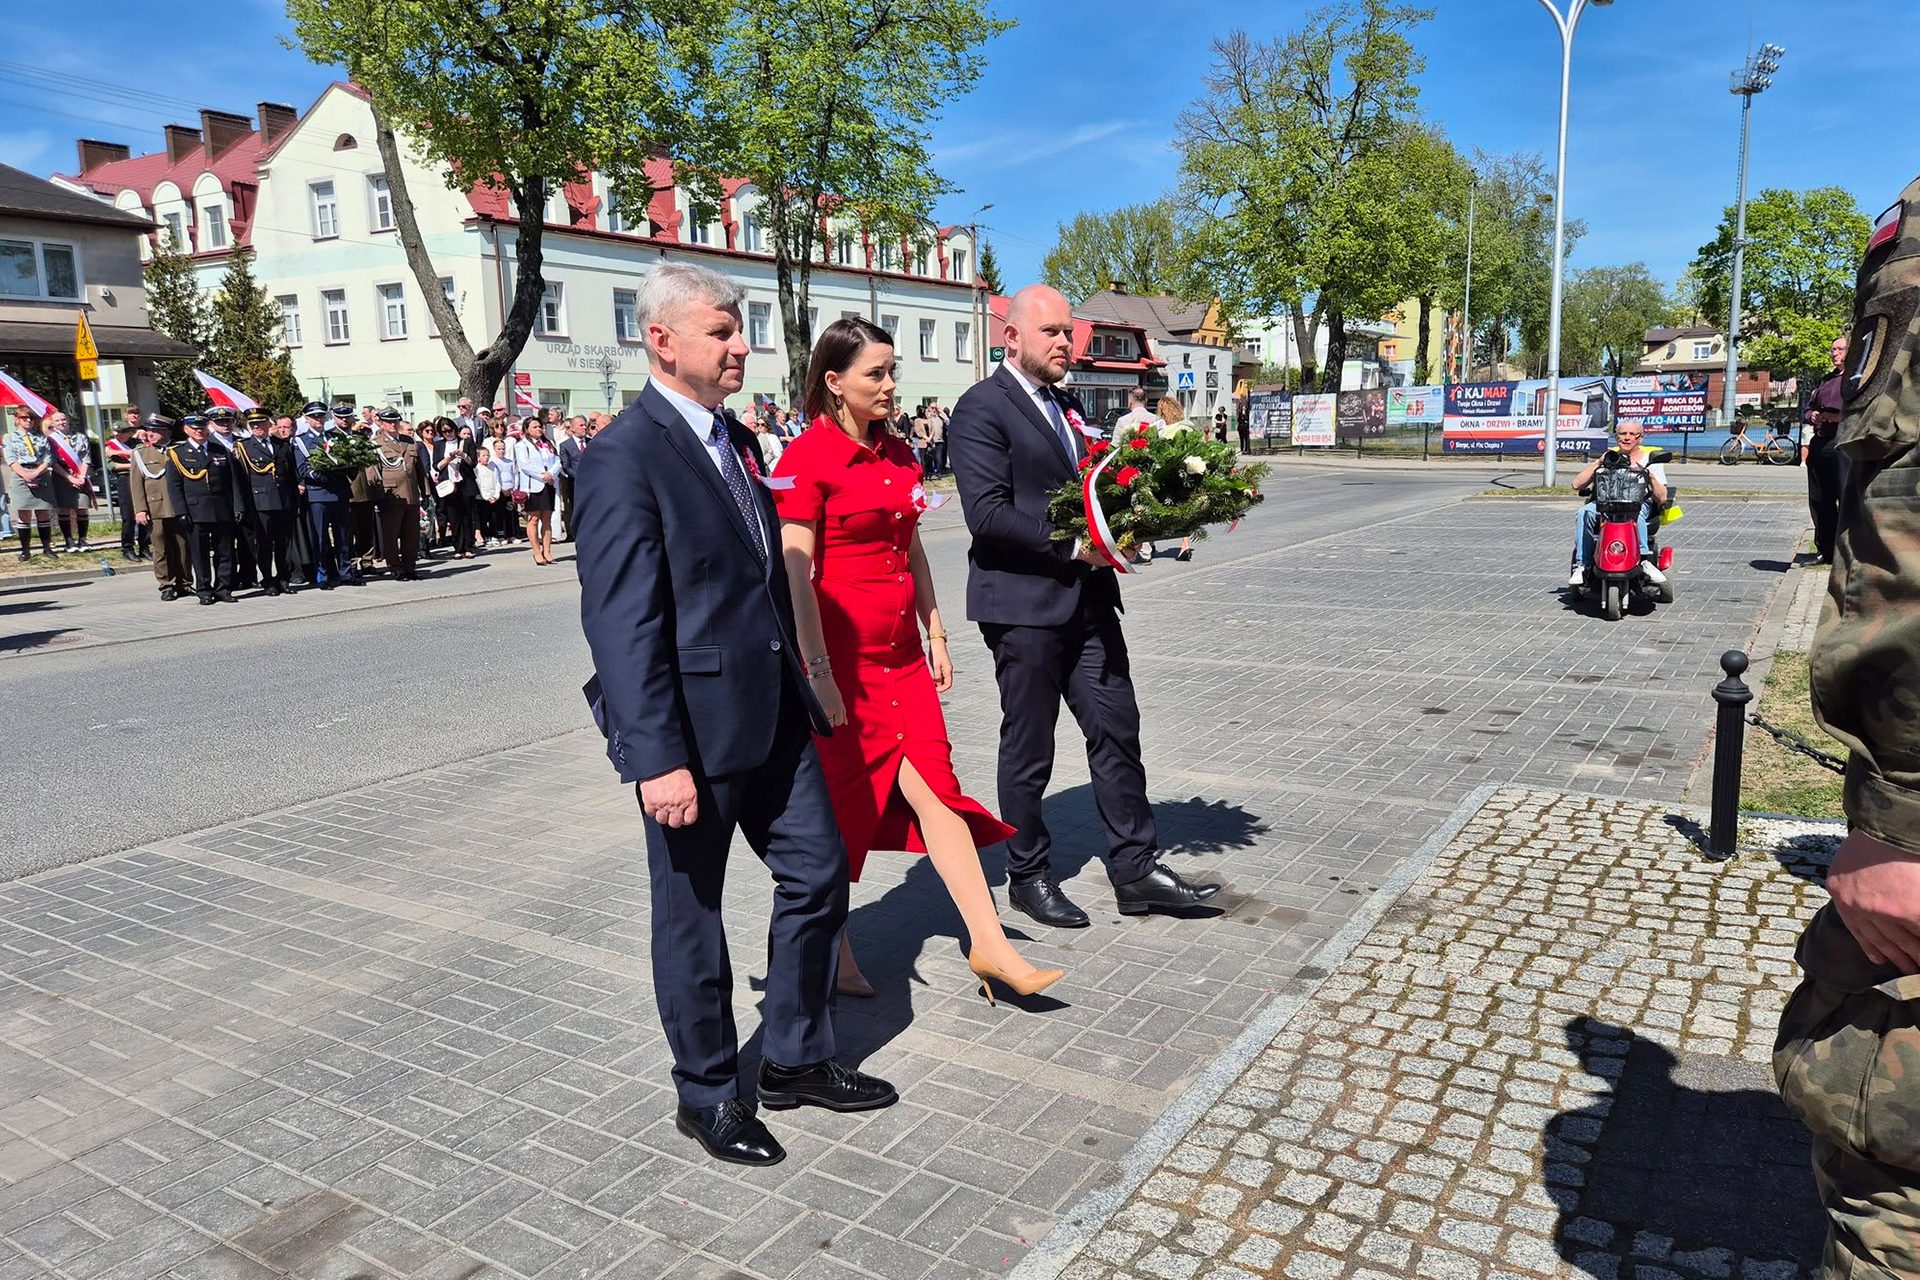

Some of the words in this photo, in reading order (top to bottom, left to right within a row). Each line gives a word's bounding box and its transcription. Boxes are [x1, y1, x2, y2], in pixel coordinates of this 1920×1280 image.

[546, 343, 581, 356] URZĄD
[584, 346, 639, 358] SKARBOWY
[567, 357, 577, 368] W
[1465, 386, 1507, 399] KAJMAR
[1618, 398, 1641, 406] PRACA
[1663, 397, 1687, 405] PRACA
[1688, 396, 1703, 404] DLA
[1618, 405, 1655, 413] SPAWACZY
[1661, 403, 1705, 412] MONTERÓW
[1460, 420, 1480, 428] OKNA
[1486, 420, 1511, 428] DRZWI
[1517, 419, 1544, 428] BRAMY
[1556, 418, 1581, 427] OLETY
[1560, 441, 1575, 450] 442
[1575, 441, 1591, 450] 972
